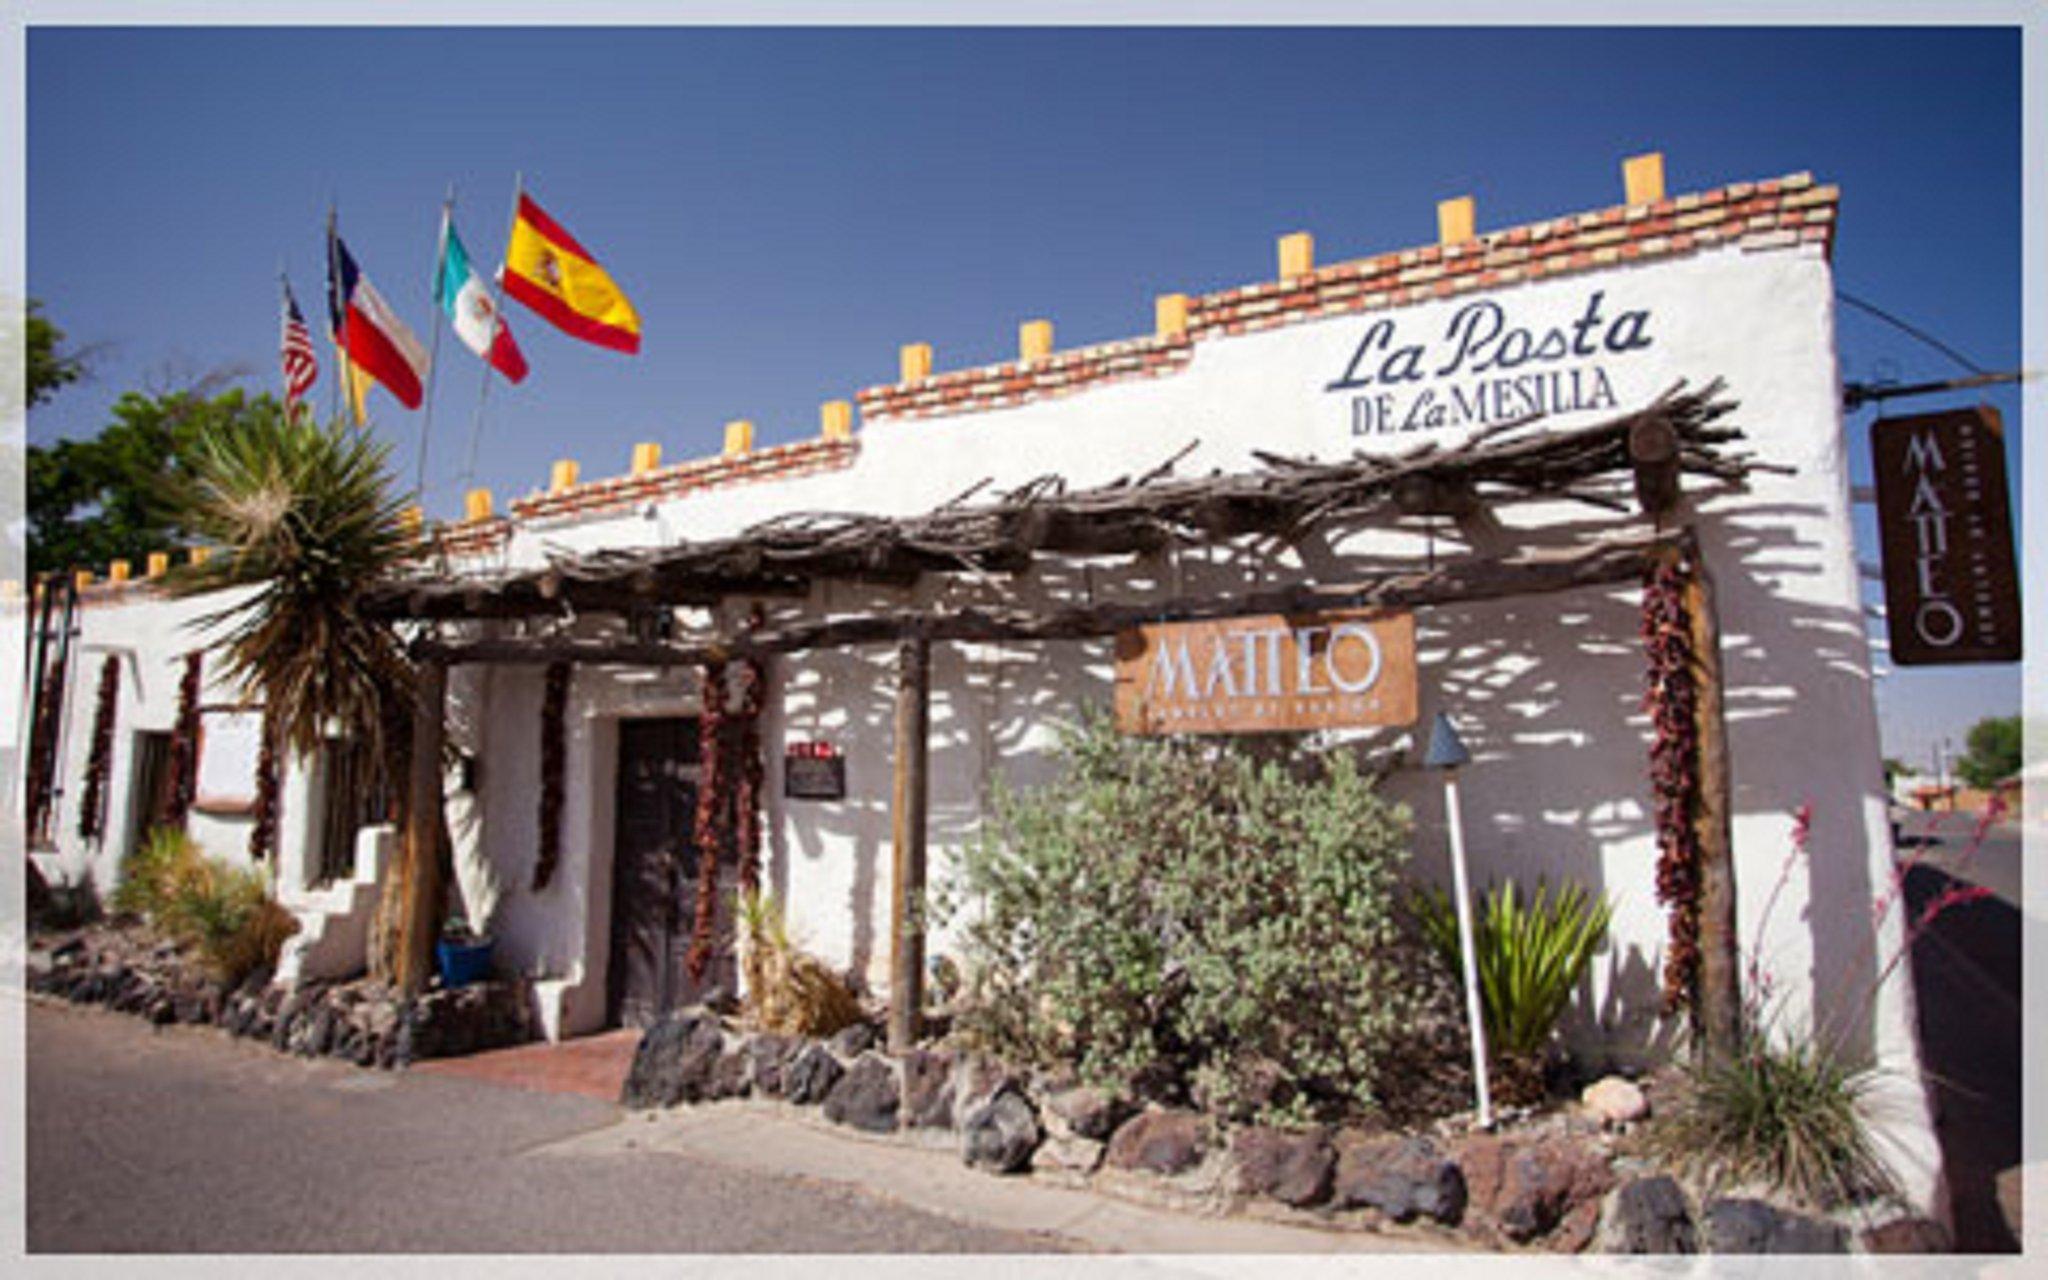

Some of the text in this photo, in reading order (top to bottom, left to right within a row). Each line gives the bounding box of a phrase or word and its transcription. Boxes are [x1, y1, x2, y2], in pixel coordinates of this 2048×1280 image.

[1324, 290, 1654, 392] La Posta
[1351, 366, 1618, 436] DE La MESILLA
[1904, 430, 1964, 646] MATTEO
[1144, 622, 1382, 700] MATTEO
